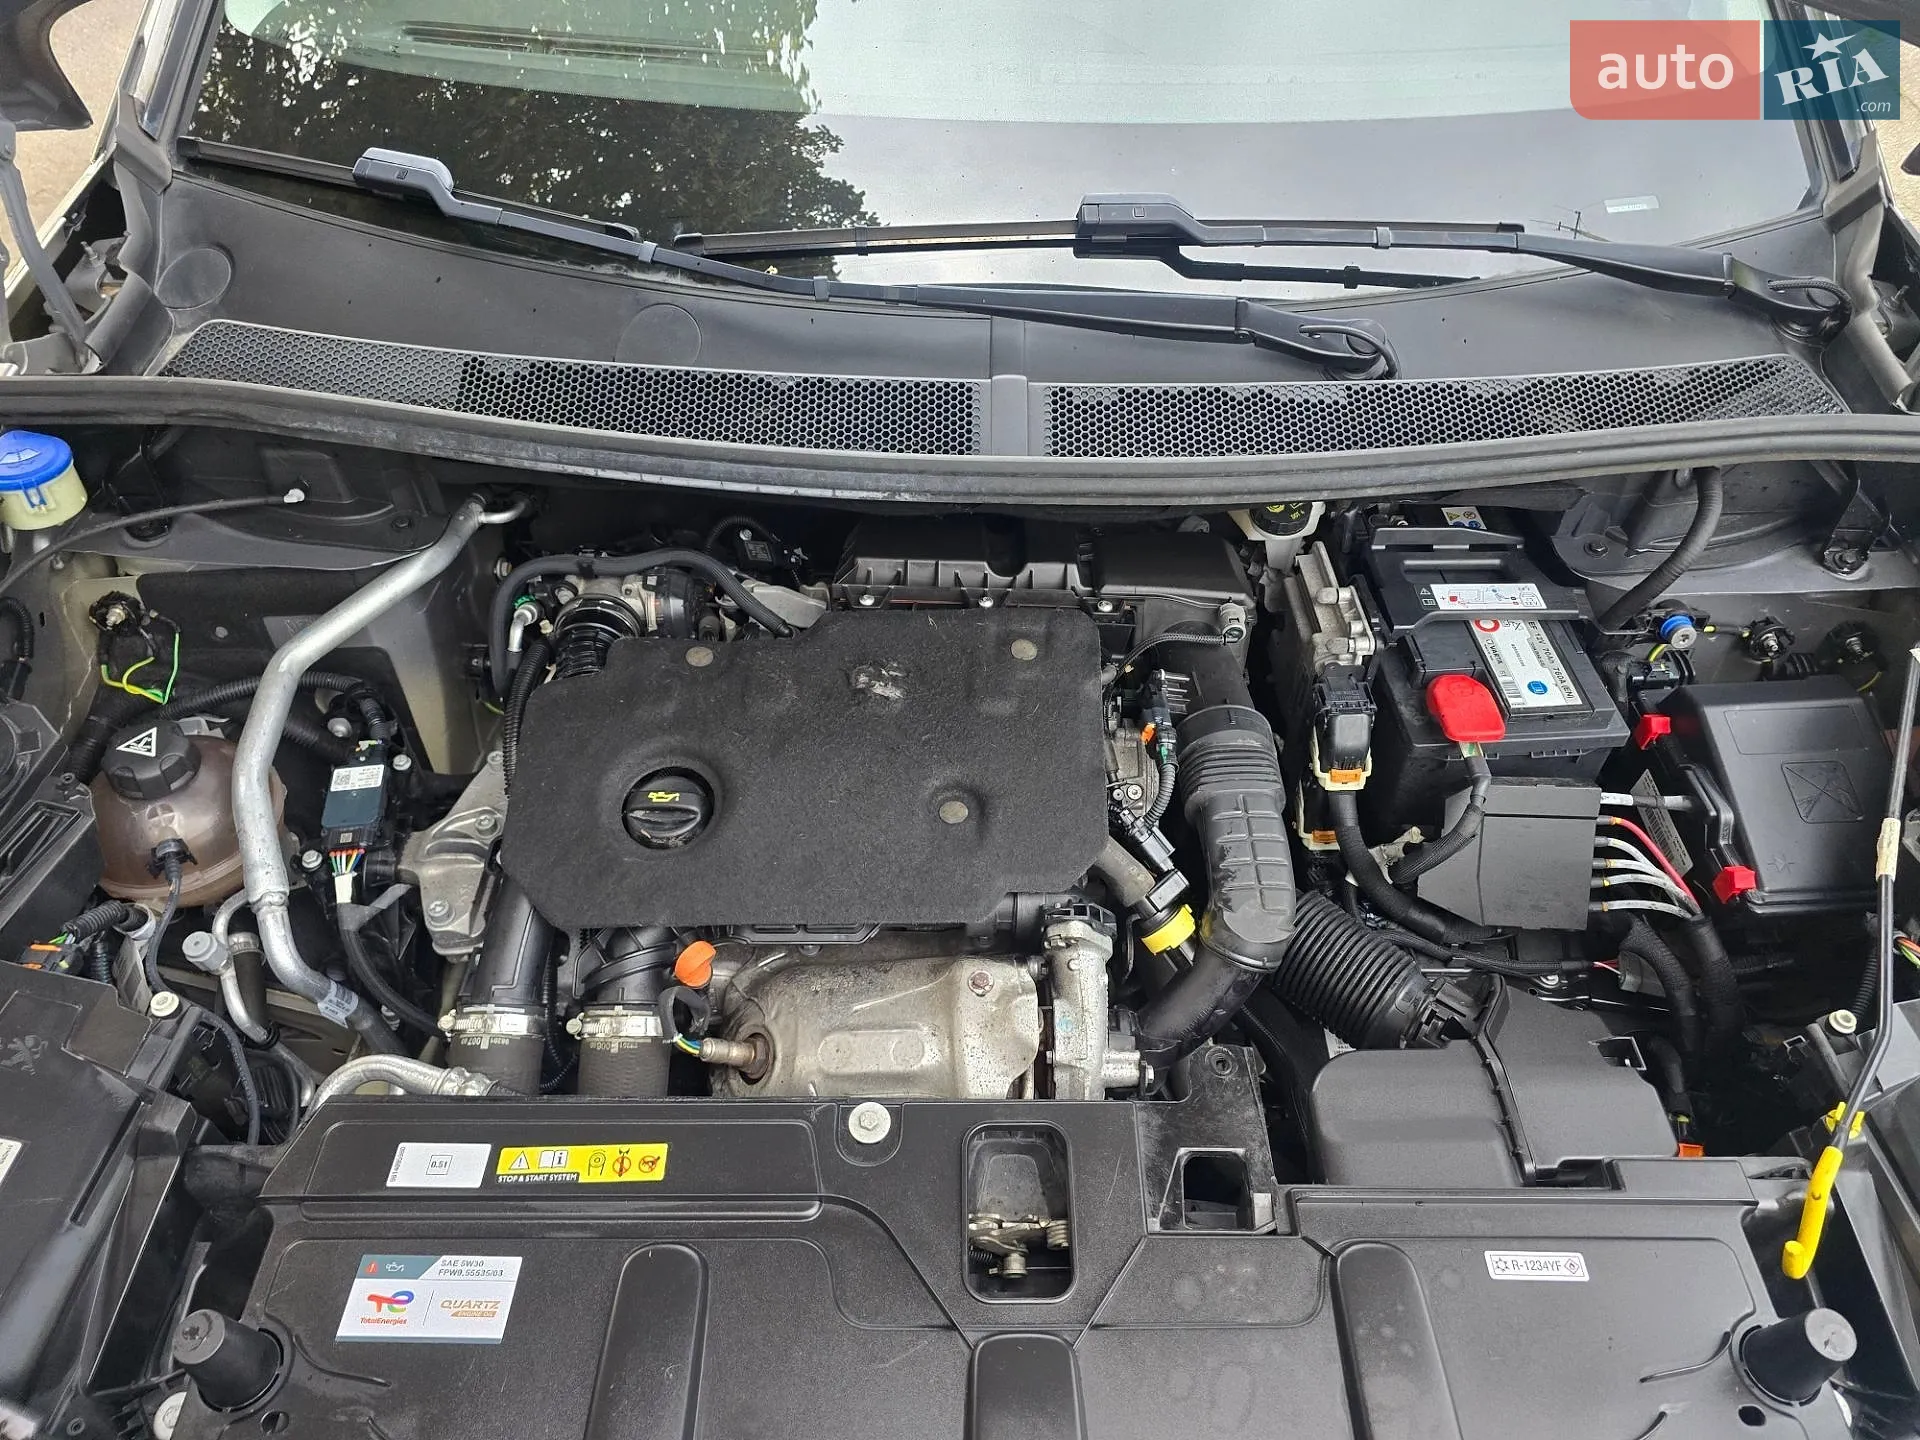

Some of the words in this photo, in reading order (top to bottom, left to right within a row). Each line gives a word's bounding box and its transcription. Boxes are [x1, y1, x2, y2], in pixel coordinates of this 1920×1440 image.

[1490, 645, 1503, 664] VARTA
[497, 1175, 518, 1183] STOP
[518, 1175, 525, 1183] &
[525, 1174, 548, 1183] START
[548, 1173, 578, 1182] SYSTEM
[1511, 1259, 1562, 1271] R-1234YF
[440, 1300, 501, 1310] QUARTZ
[360, 1317, 408, 1325] TotalEnergies
